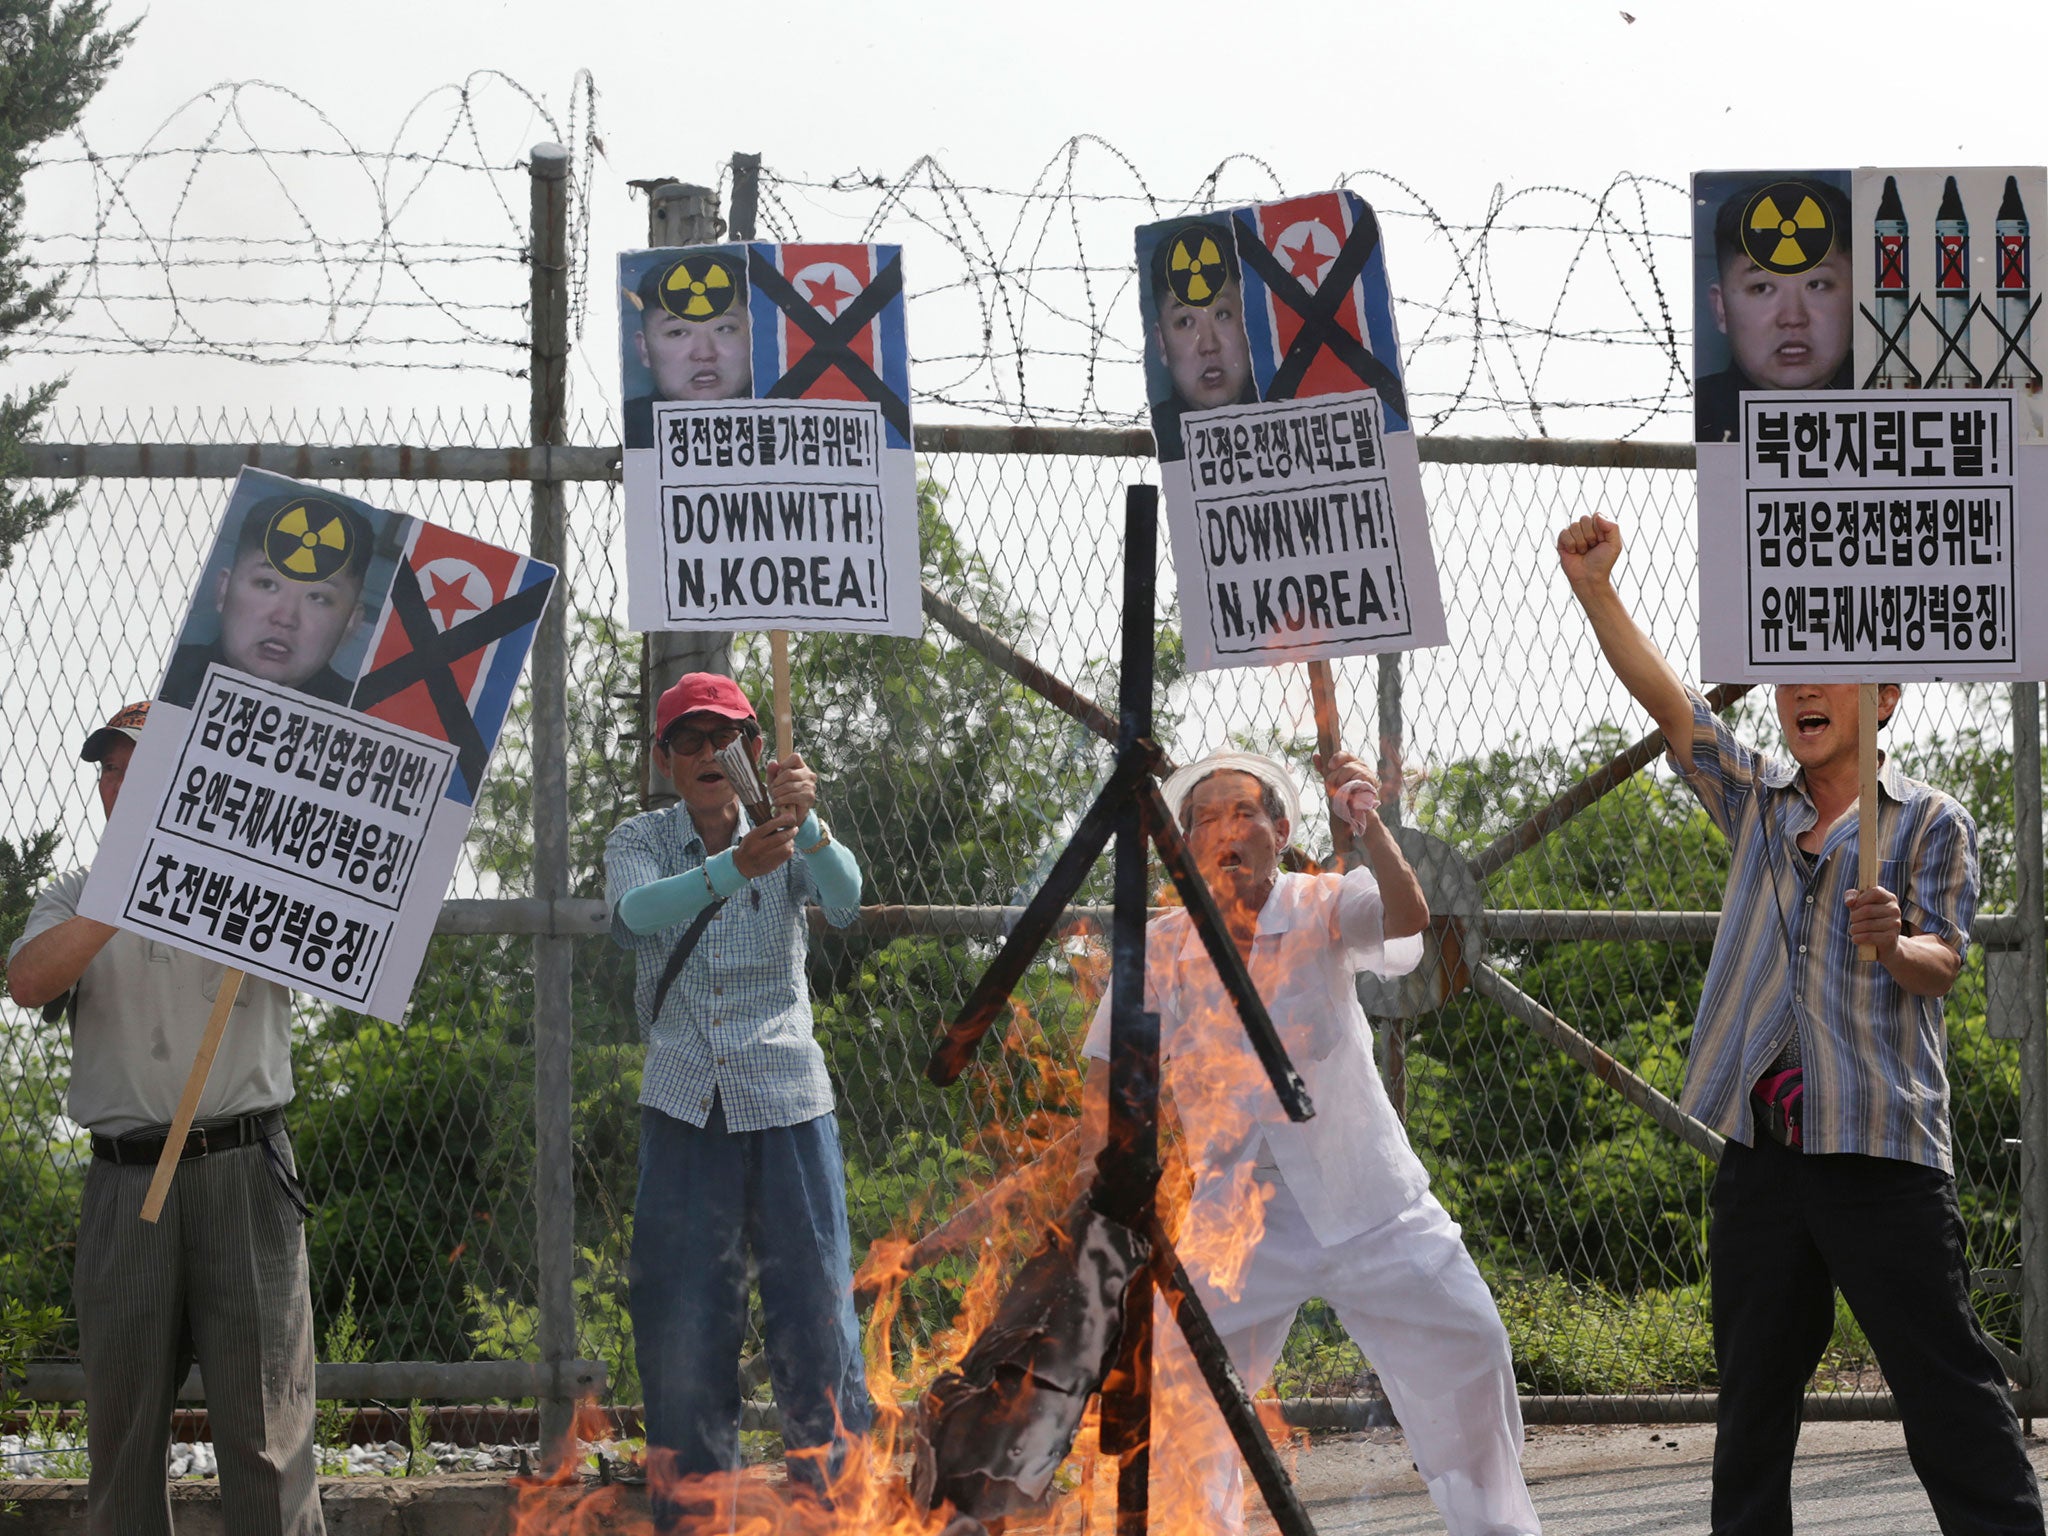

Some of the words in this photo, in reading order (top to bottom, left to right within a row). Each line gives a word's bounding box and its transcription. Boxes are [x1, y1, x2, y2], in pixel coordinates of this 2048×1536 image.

[669, 415, 870, 467] 정전협정불가침위반!
[1756, 410, 1998, 478] 북한지뢰도발!
[1756, 499, 2001, 567] 김정은정전협정위반!
[678, 556, 877, 613] N,KOREA!
[1217, 565, 1400, 641] N,KOREA!
[1761, 584, 2006, 652] 유엔국제사회강력응징!
[201, 689, 436, 816] 김정은정전협정위반!
[175, 766, 412, 897] 유엔국제사회강력응징!
[138, 854, 378, 985] 초전박살강력응징!
